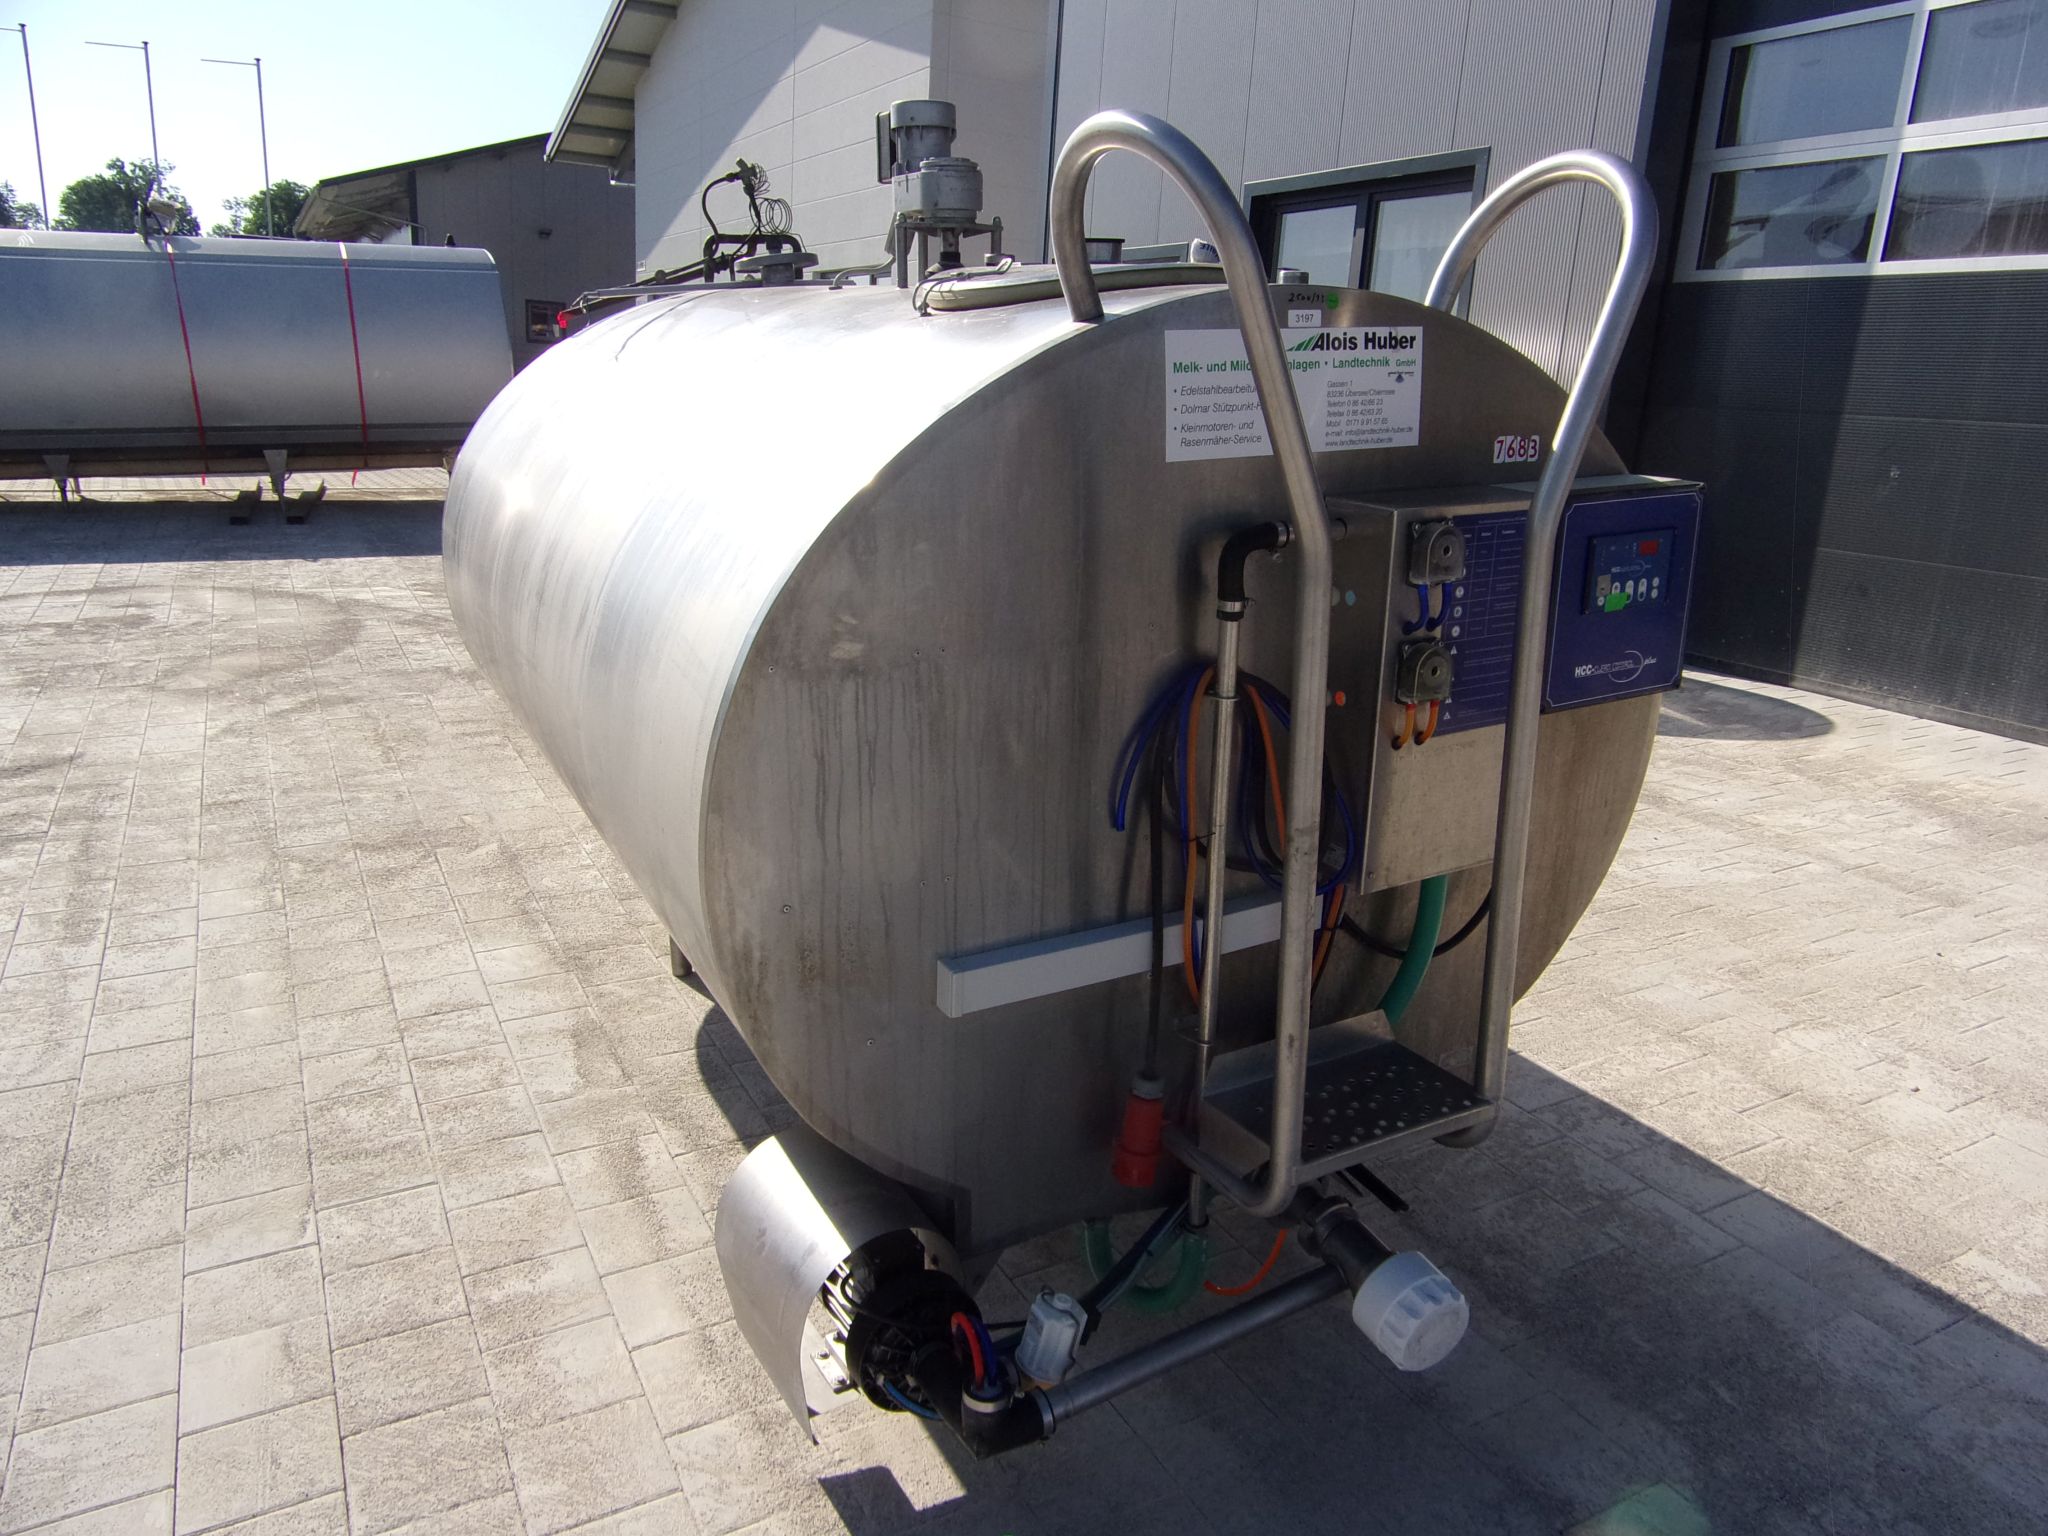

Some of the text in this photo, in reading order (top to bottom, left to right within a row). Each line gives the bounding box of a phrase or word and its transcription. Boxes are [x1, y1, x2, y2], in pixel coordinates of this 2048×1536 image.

[1295, 314, 1314, 324] 3197
[1311, 331, 1417, 351] Alois Huber
[1173, 361, 1203, 374] Melk-
[1207, 360, 1227, 372] und
[1332, 356, 1390, 368] Landtechnik
[1395, 358, 1417, 367] GmbH
[1180, 383, 1257, 396] Edelstahlbearbeitu
[1238, 420, 1255, 430] und
[1180, 434, 1263, 447] Rasenmäher-Service
[1496, 438, 1538, 460] 7683
